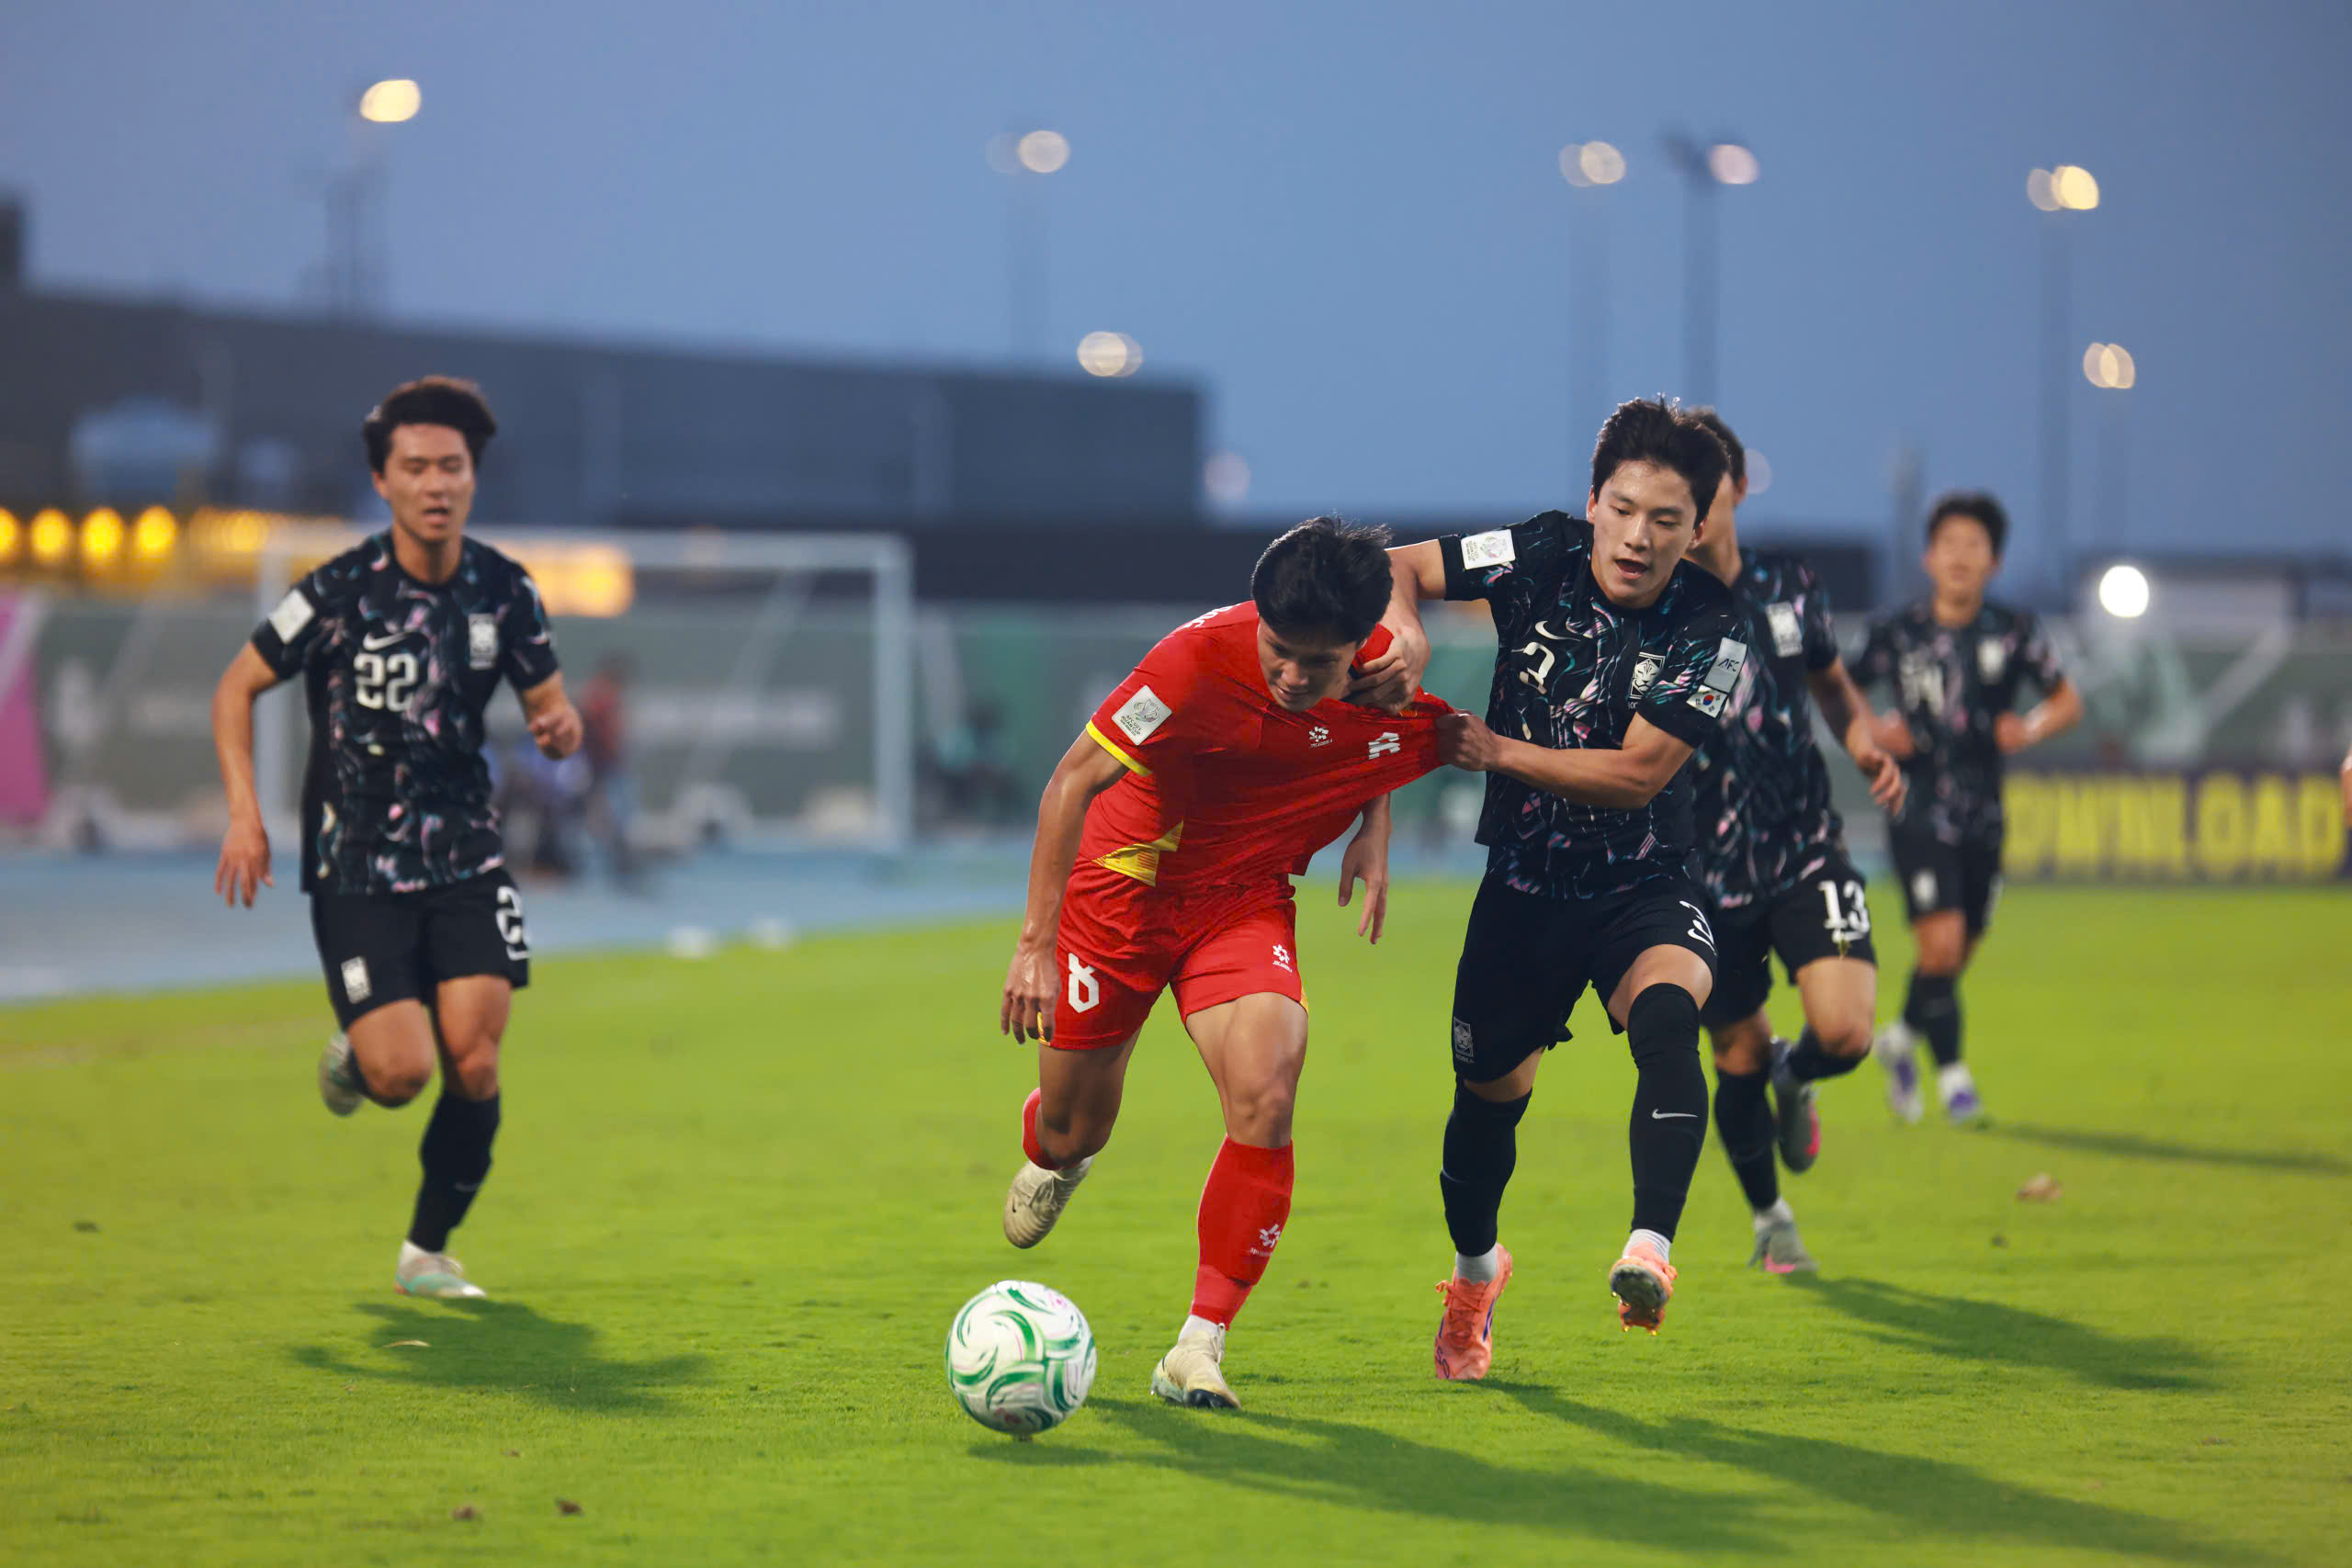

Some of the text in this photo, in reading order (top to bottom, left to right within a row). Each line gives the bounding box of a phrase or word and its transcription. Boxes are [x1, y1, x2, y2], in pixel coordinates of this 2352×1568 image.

[354, 653, 419, 712] 22
[2001, 773, 2344, 871] OWNLOAD
[1818, 879, 1871, 934] 13
